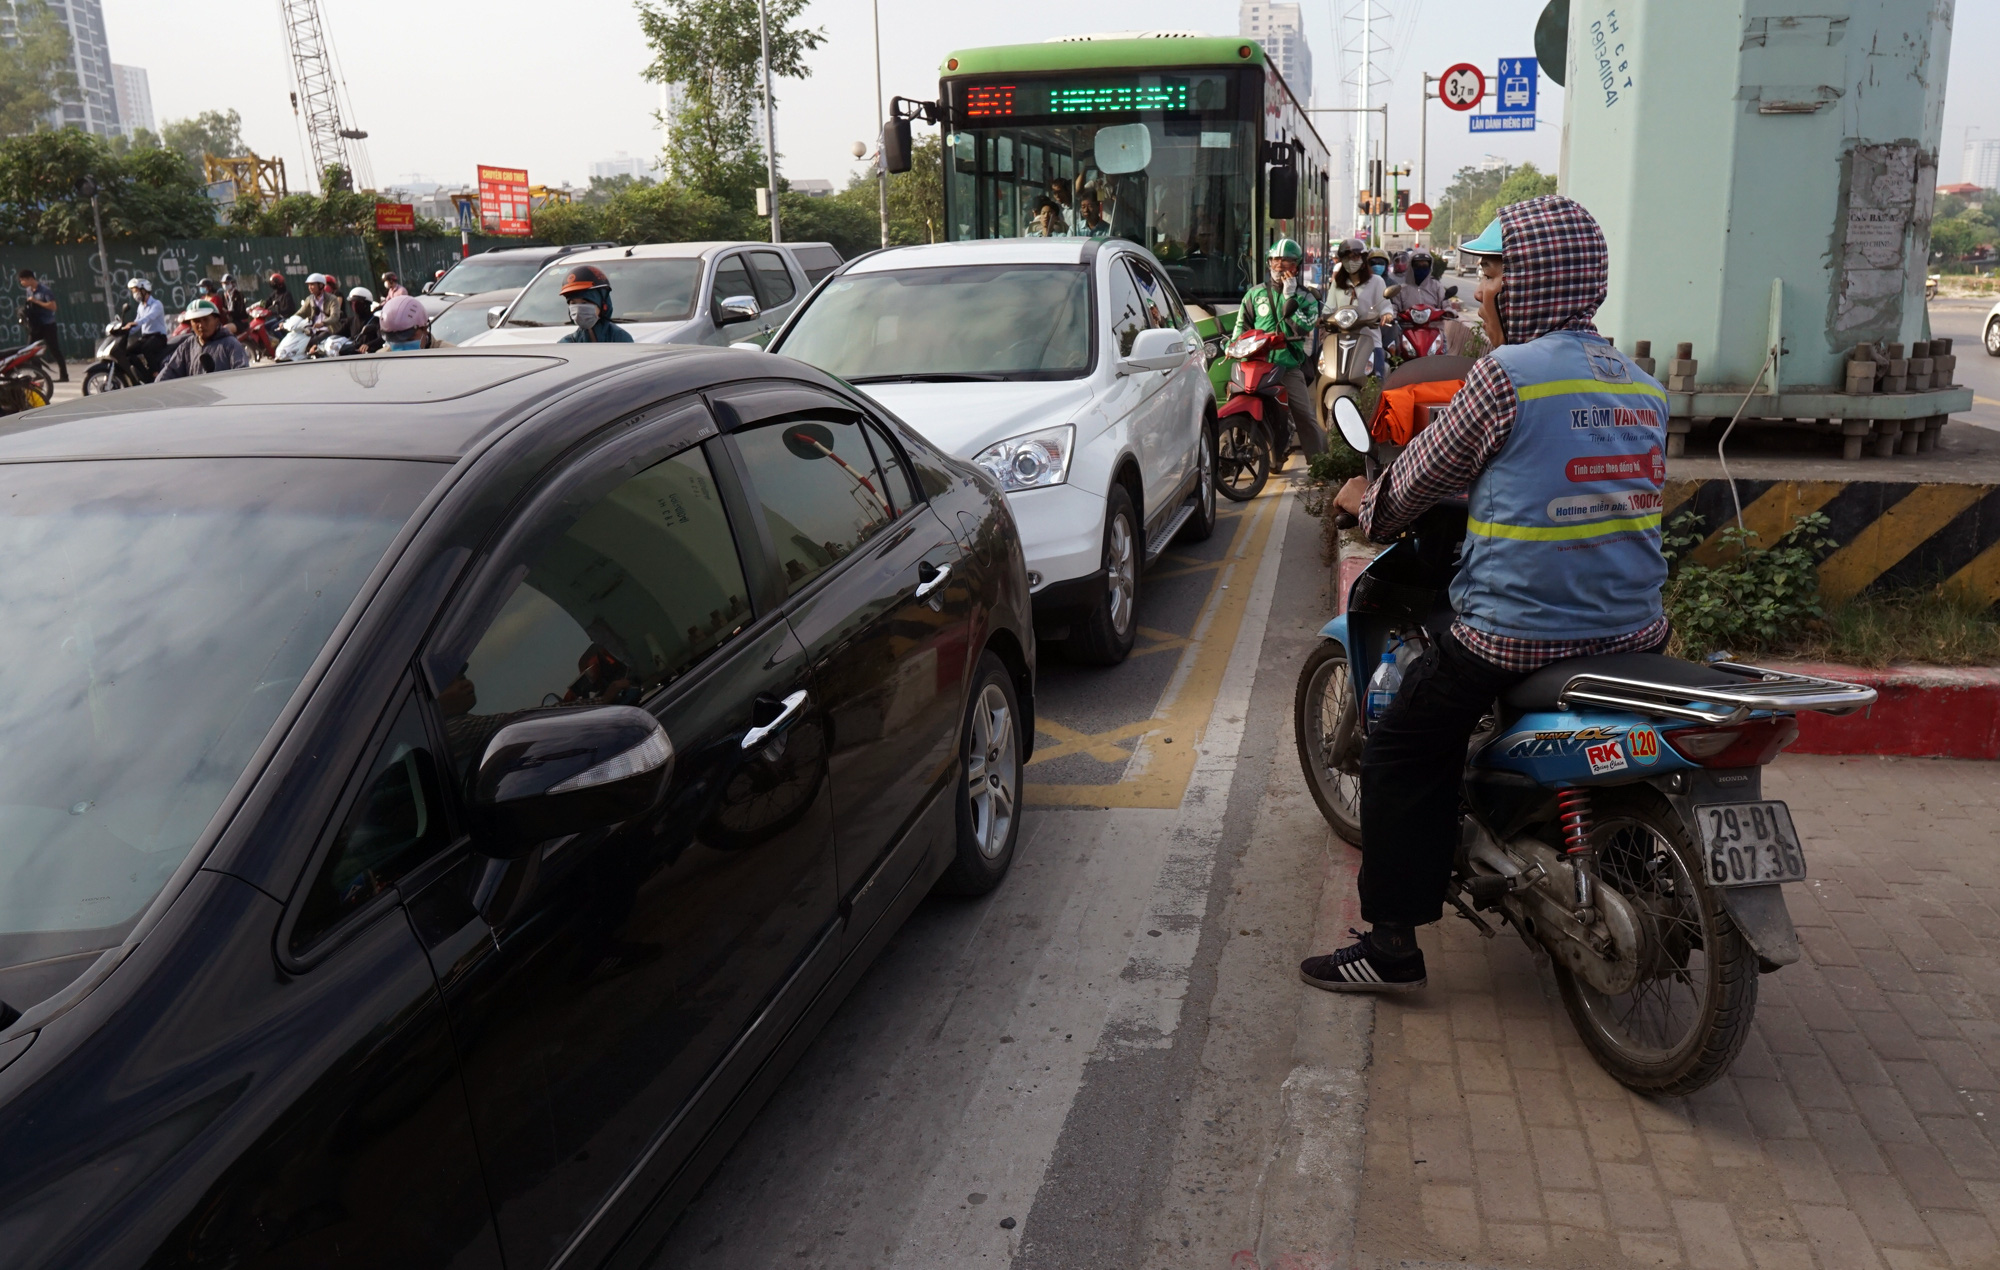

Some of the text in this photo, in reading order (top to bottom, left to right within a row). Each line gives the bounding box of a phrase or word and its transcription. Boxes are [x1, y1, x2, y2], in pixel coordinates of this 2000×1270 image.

[1590, 20, 1618, 108] 0913411041
[1472, 116, 1534, 130] LÀN DÀNH RIÊNG BRT
[1571, 409, 1589, 430] XE
[1591, 406, 1611, 429] ÔM
[1605, 462, 1619, 474] theo
[1556, 506, 1588, 517] Hotline
[1535, 732, 1571, 741] WAVE
[1628, 730, 1658, 758] 120
[1588, 743, 1621, 765] RK
[1718, 775, 1749, 783] HONDA
[1709, 805, 1786, 842] 29-B1
[1710, 842, 1801, 883] 607.36
